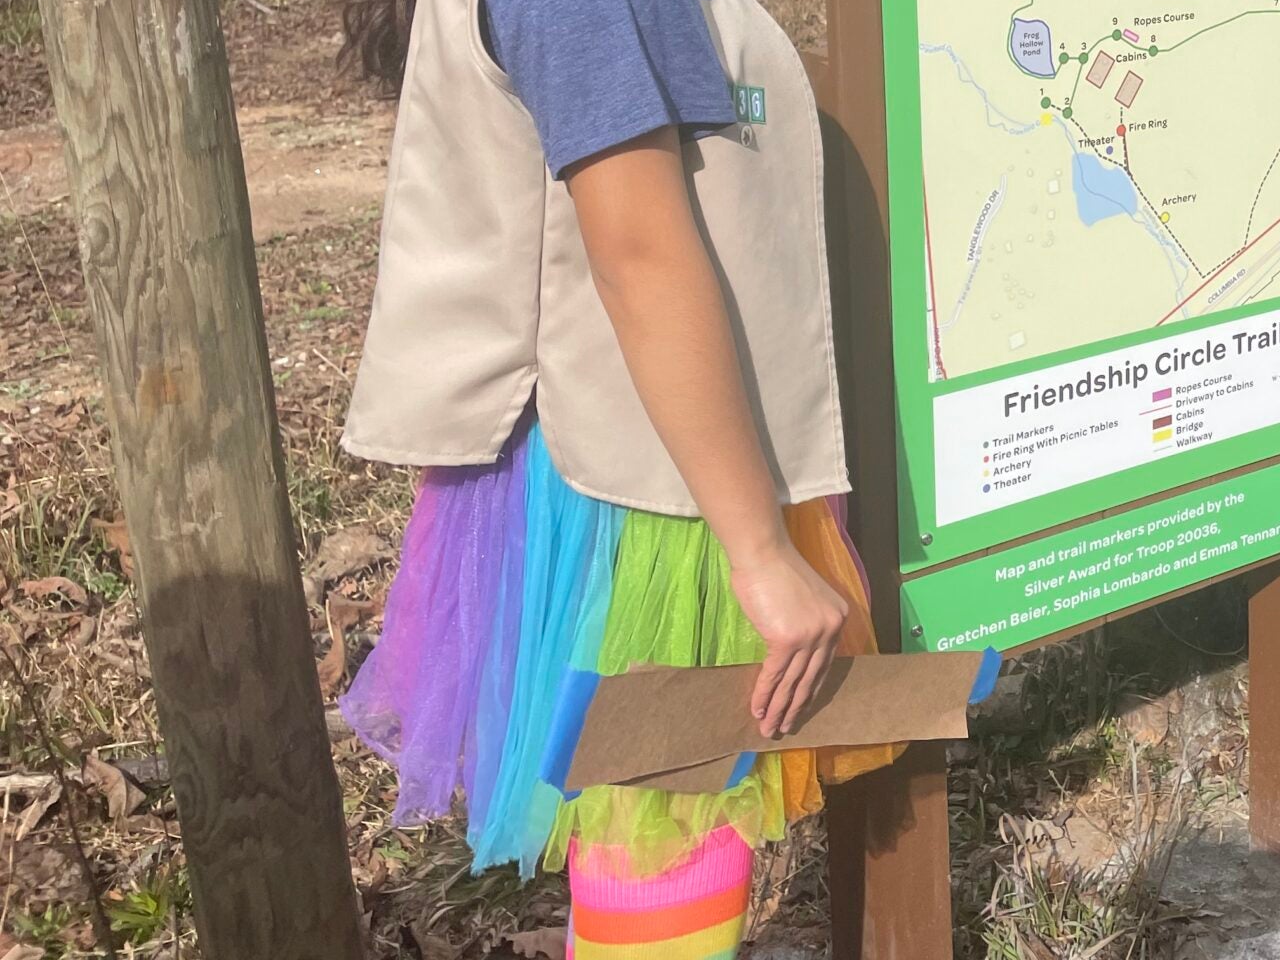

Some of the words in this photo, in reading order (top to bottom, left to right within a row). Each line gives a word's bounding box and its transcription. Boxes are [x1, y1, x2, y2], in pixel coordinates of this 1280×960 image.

[1112, 17, 1118, 26] 9
[1134, 16, 1161, 26] Ropes
[1163, 12, 1195, 23] Course
[1023, 32, 1040, 41] Frog
[1150, 35, 1156, 43] 8
[1019, 40, 1044, 49] Hollow
[1059, 42, 1065, 50] 4
[1081, 42, 1087, 50] 3
[1022, 48, 1041, 57] Pond
[1116, 52, 1147, 63] Cabins
[1040, 88, 1044, 96] 1
[1064, 97, 1070, 106] 2
[1128, 123, 1146, 132] Fire
[1148, 118, 1168, 128] Ring
[1078, 136, 1115, 148] Theater
[1162, 193, 1197, 206] Archery
[967, 202, 992, 261] TANGLEWOOD
[988, 189, 1000, 204] DR
[1207, 275, 1238, 304] COLUMBIA
[1004, 360, 1148, 417] Friendship
[1155, 340, 1226, 376] Circle
[1176, 382, 1201, 395] Ropes
[1203, 373, 1233, 387] Course
[1176, 392, 1214, 408] Driveway
[1226, 380, 1254, 394] Cabins
[1176, 407, 1205, 421] Cabins
[1176, 420, 1204, 434] Bridge
[992, 434, 1014, 447] Trail
[1016, 425, 1054, 441] Markers
[993, 450, 1012, 462] Fire
[1014, 443, 1034, 456] Ring
[1036, 436, 1058, 449] With
[1060, 428, 1088, 443] Picnic
[1089, 420, 1119, 434] Tables
[1176, 431, 1213, 448] Walkway
[993, 459, 1032, 476] Archery
[993, 473, 1032, 490] Theater
[995, 564, 1025, 582] Map
[1028, 552, 1055, 571] and
[1058, 542, 1086, 561] trail
[1089, 526, 1145, 551] markers
[1147, 503, 1204, 535] provided
[1207, 500, 1222, 513] by
[1224, 493, 1245, 507] the
[1024, 574, 1065, 597] Silver
[1068, 558, 1111, 582] Award
[1113, 551, 1134, 566] for
[1136, 539, 1175, 559] Troop
[1177, 522, 1221, 546] 20036,
[937, 619, 1006, 651] Gretchen
[1010, 605, 1050, 627] Beier,
[1053, 587, 1100, 612] Sophia
[1103, 561, 1171, 594] Lombardo
[1173, 551, 1197, 570] and
[1200, 540, 1238, 561] Emma
